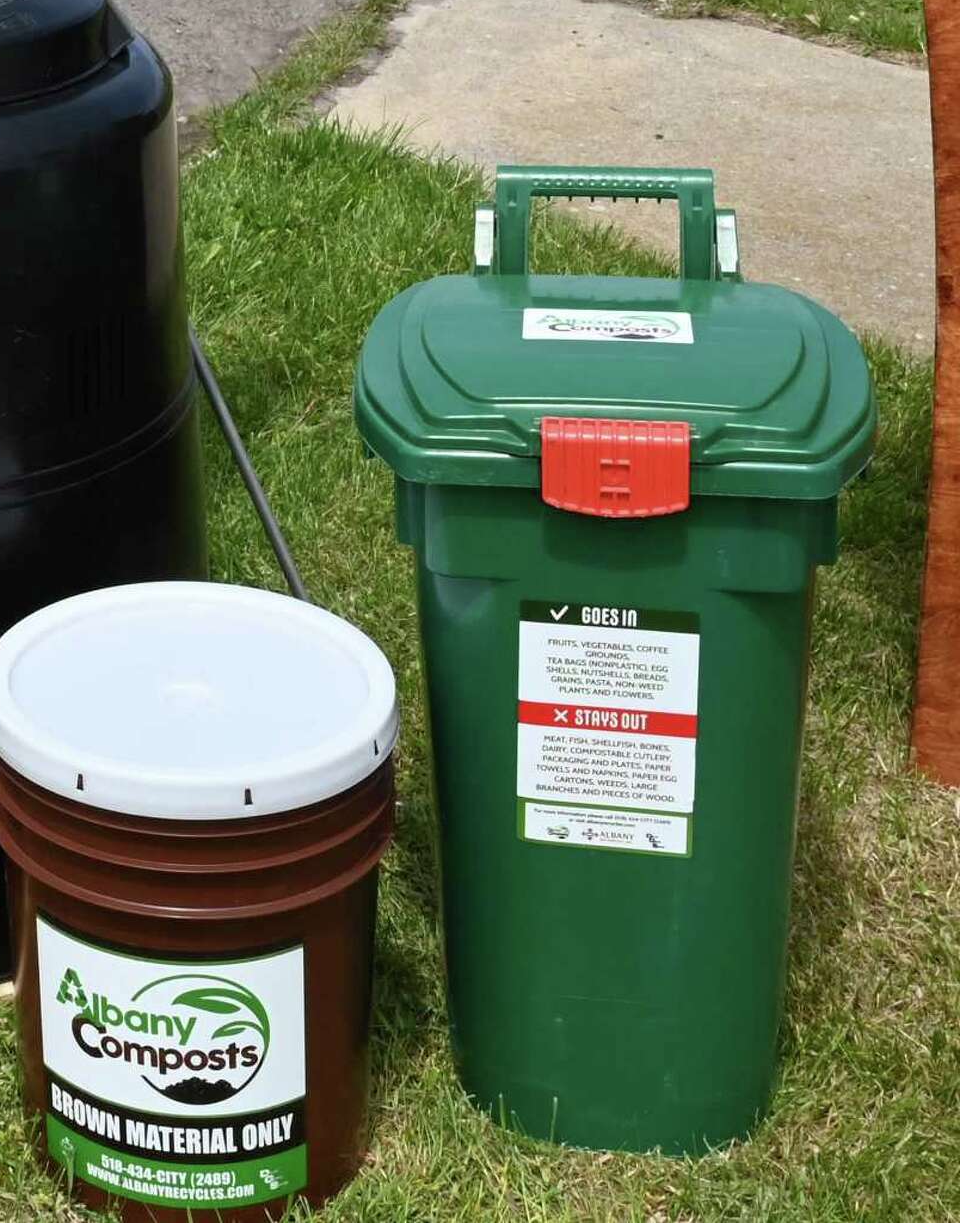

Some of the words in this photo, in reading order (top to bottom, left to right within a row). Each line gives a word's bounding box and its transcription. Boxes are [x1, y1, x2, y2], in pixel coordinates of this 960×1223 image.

[549, 323, 672, 333] Composts
[582, 607, 619, 626] GOES
[636, 645, 668, 654] COFFEE
[548, 657, 562, 665] TEA
[565, 658, 586, 666] BAGS
[559, 686, 590, 695] PLANTS
[593, 688, 610, 696] AND
[575, 709, 617, 728] STAYS
[622, 713, 647, 730] OUT
[571, 747, 630, 758] COMPOSTABLE
[543, 755, 589, 765] PACKAGING
[645, 763, 671, 771] PAPER
[537, 764, 569, 773] TOWELS
[572, 767, 590, 775] AND
[632, 773, 657, 781] PAPER
[660, 774, 677, 783] EGG
[536, 784, 579, 794] BRANCHES
[602, 789, 630, 798] PIECES
[631, 783, 657, 791] LARGE
[56, 967, 196, 1046] Albany
[72, 1014, 258, 1074] Composts
[51, 1082, 121, 1141] BROWN
[125, 1118, 237, 1155] MATERIAL
[241, 1113, 294, 1151] ONLY
[101, 1154, 187, 1185] 518-434-CITY
[190, 1171, 236, 1187] (2489)
[87, 1162, 255, 1201] WWW.ALBANYRECYCLES.COM
